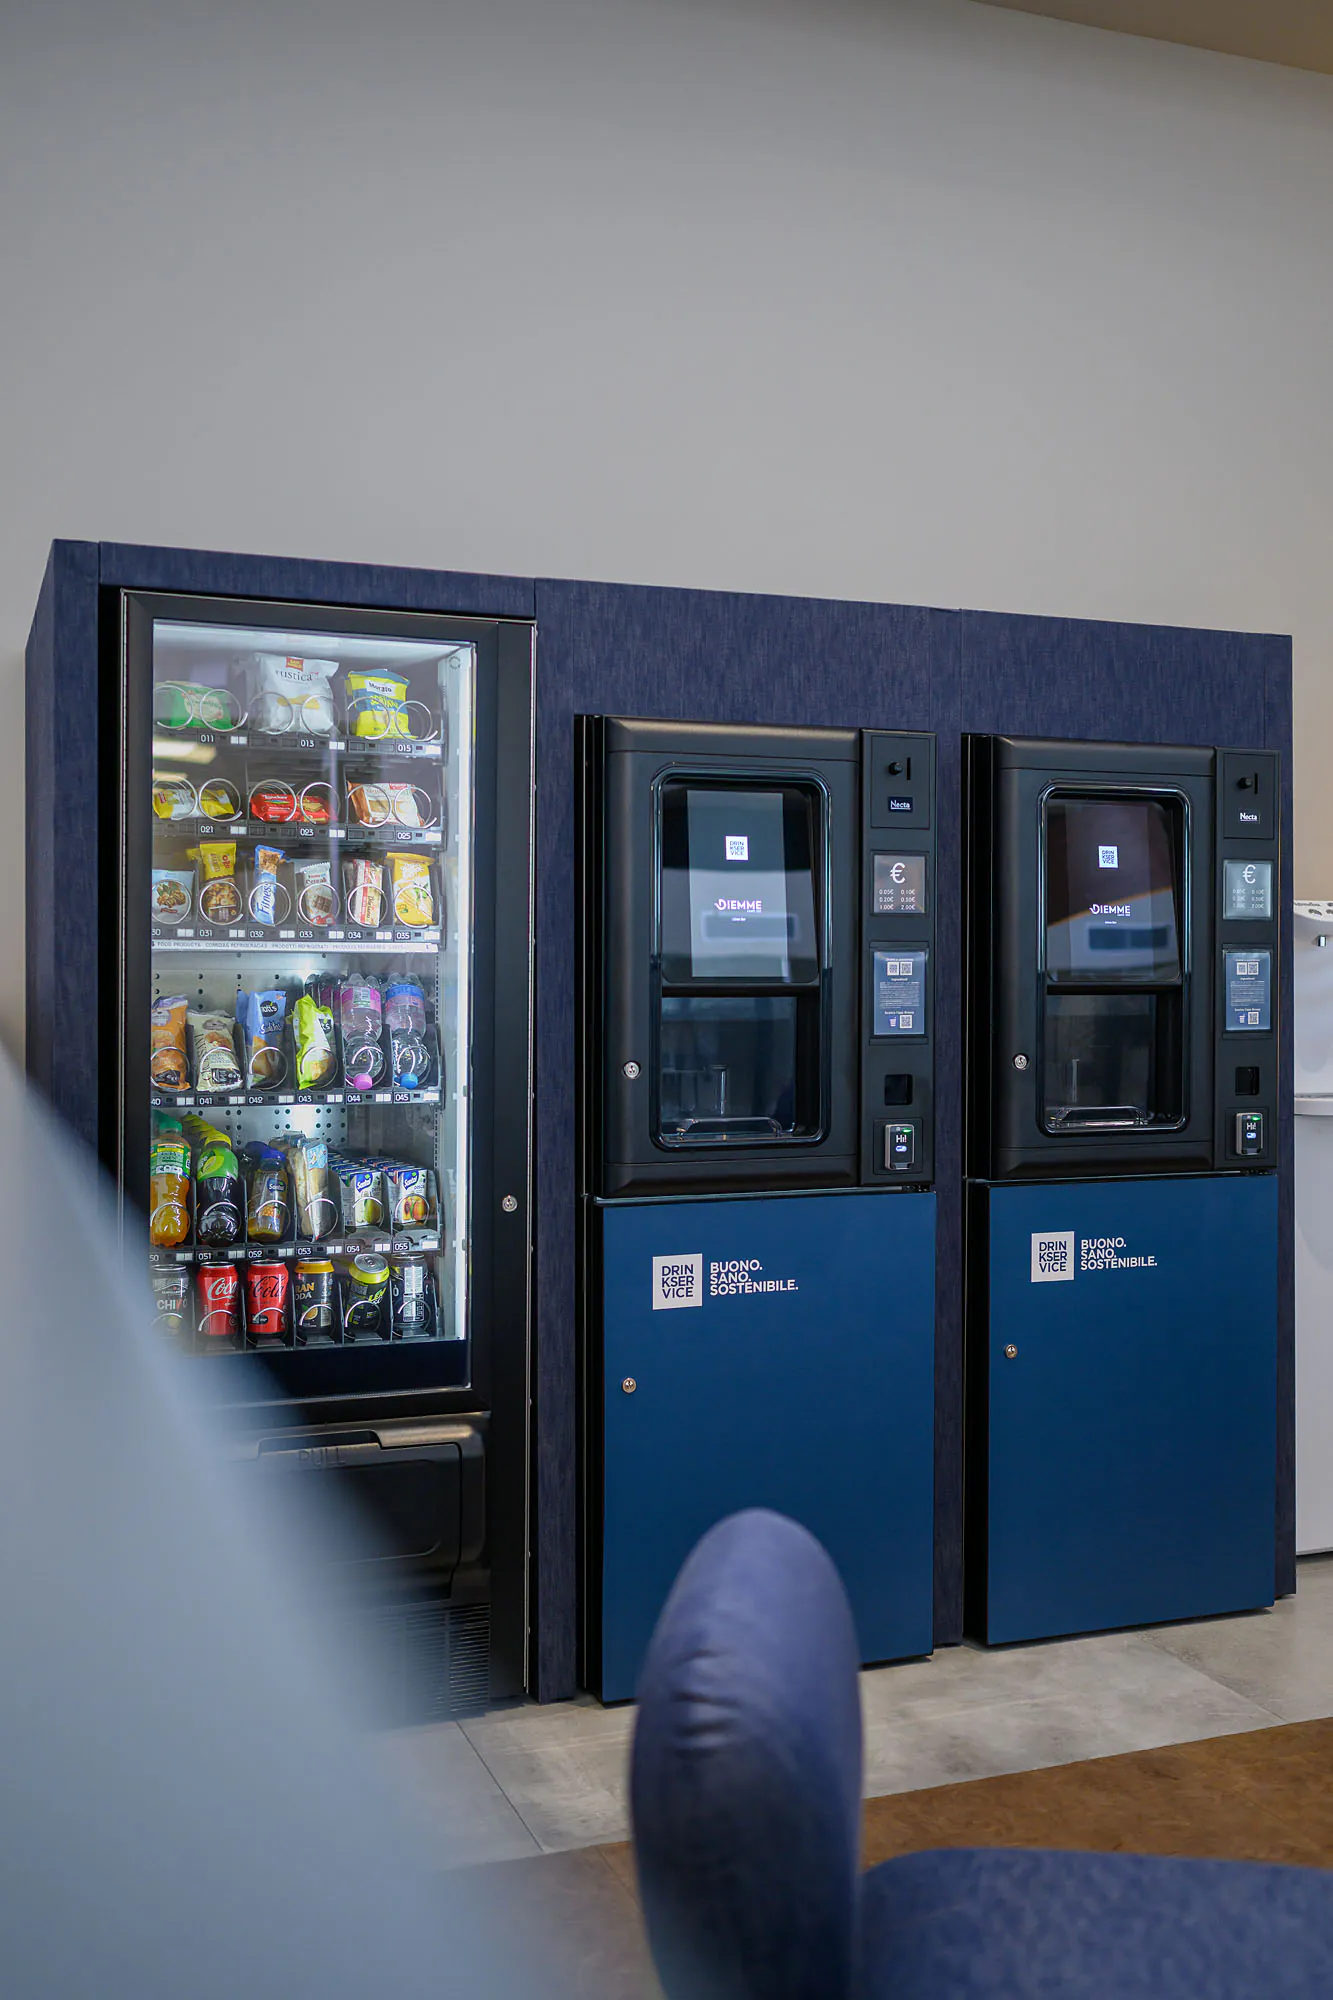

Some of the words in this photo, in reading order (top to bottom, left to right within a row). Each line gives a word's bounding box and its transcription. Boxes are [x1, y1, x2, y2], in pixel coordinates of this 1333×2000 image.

[200, 734, 214, 742] 011
[300, 739, 315, 747] 013
[397, 744, 411, 752] 015
[890, 800, 911, 809] Necta
[1239, 812, 1258, 821] Necta
[200, 825, 214, 833] 021
[300, 828, 314, 836] 023
[397, 832, 411, 840] 025
[714, 898, 762, 911] DIEMME
[1089, 903, 1131, 915] DIEMME
[152, 928, 161, 936] 30
[199, 929, 213, 937] 031
[249, 930, 264, 938] 032
[299, 930, 313, 938] 033
[396, 932, 410, 940] 035
[199, 1097, 213, 1105] 041
[248, 1096, 263, 1104] 042
[298, 1095, 312, 1103] 043
[395, 1093, 409, 1101] 045
[151, 1097, 160, 1106] 40
[896, 1134, 907, 1143] Hi!
[394, 1243, 408, 1251] 055
[1039, 1240, 1067, 1252] DRIN
[1080, 1237, 1127, 1250] BUONO.
[297, 1247, 311, 1255] 053
[346, 1245, 360, 1253] 054
[149, 1254, 160, 1262] 50
[198, 1252, 212, 1260] 051
[248, 1250, 263, 1258] 052
[1038, 1251, 1068, 1263] KSER
[1080, 1248, 1117, 1260] SANO.
[709, 1259, 763, 1274] BUONO.
[1039, 1261, 1067, 1273] VICE
[1080, 1255, 1158, 1271] SOSTENIBILE.
[661, 1264, 694, 1277] DRIN
[661, 1275, 695, 1288] KSER
[709, 1271, 752, 1285] SANO.
[253, 1275, 285, 1298] Cola
[295, 1282, 315, 1293] RAN
[709, 1279, 799, 1296] SOSTENIBILE.
[296, 1291, 312, 1301] ODA
[662, 1286, 694, 1299] VICE
